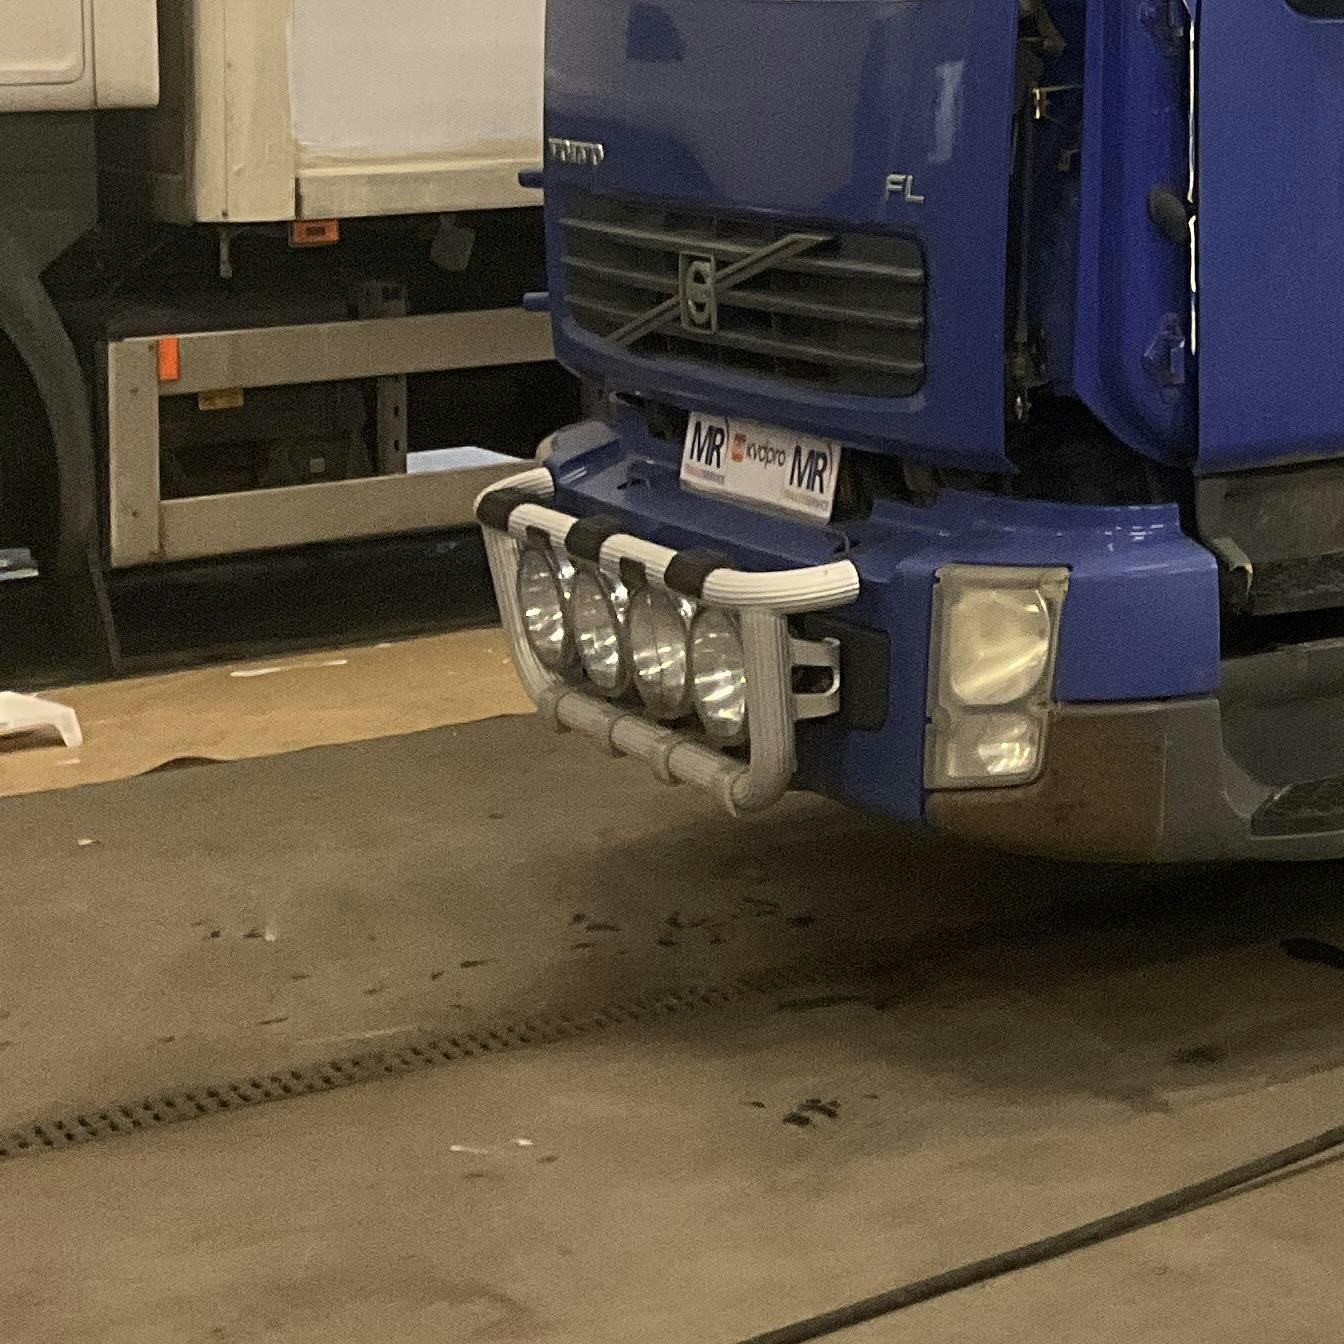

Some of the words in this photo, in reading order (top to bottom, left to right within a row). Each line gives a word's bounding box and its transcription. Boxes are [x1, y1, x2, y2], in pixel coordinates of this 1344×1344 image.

[885, 173, 925, 203] FL
[690, 420, 725, 469] MR
[789, 443, 828, 494] MR
